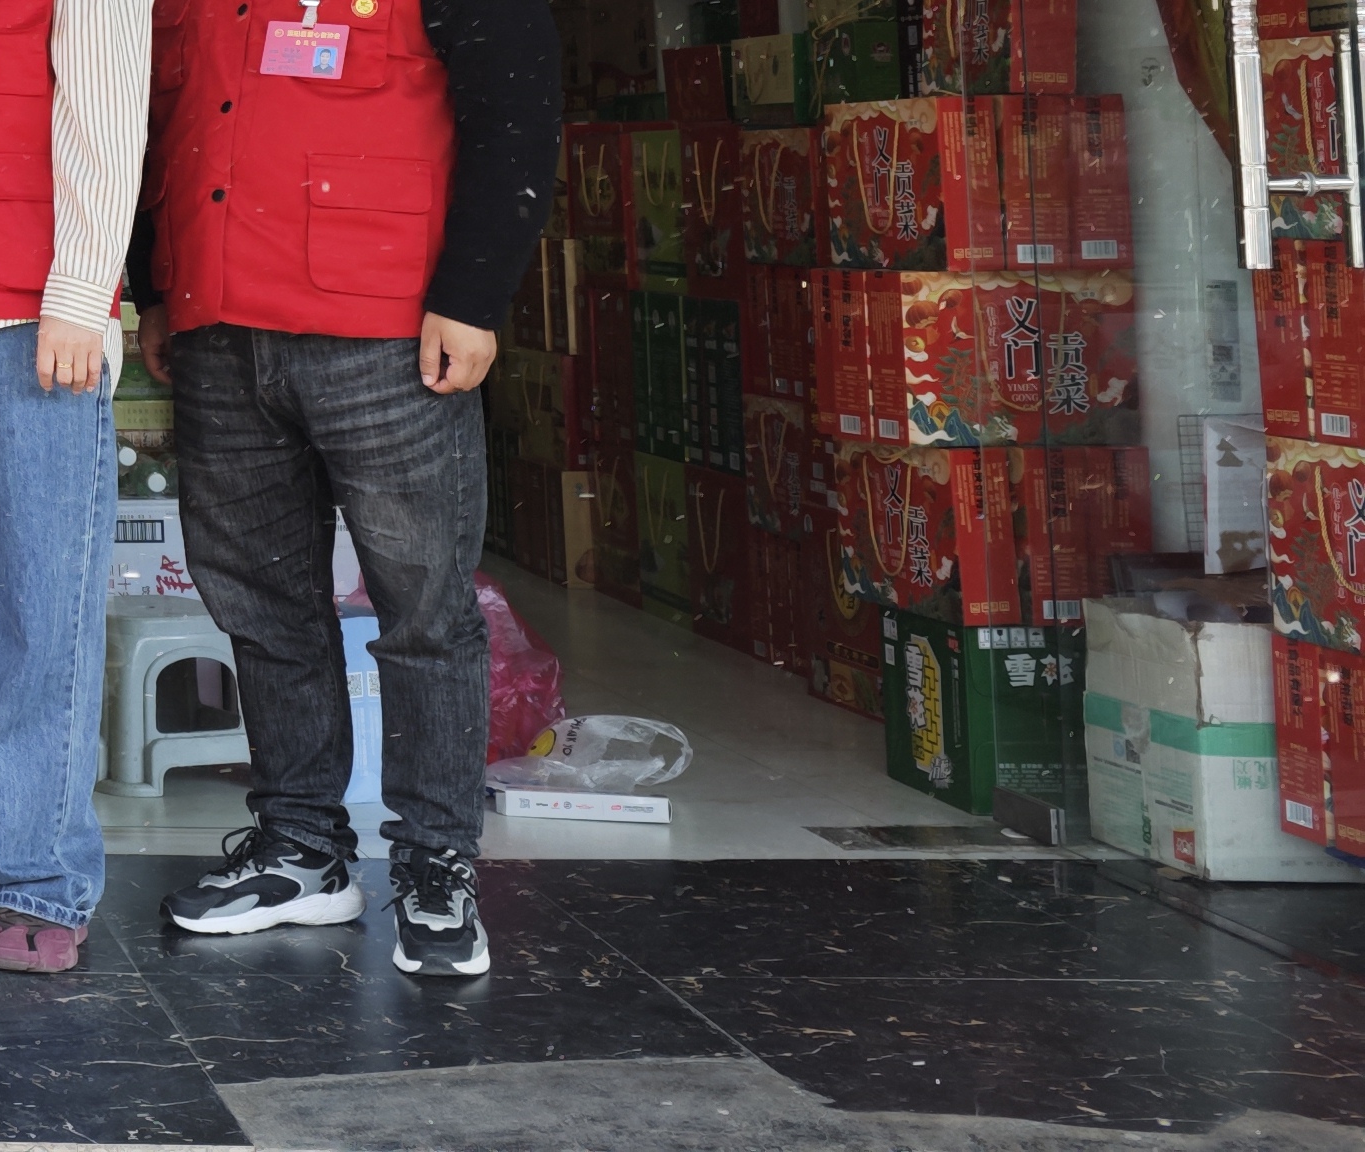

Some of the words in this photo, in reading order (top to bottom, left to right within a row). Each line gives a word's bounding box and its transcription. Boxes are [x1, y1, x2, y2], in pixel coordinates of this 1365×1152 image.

[1001, 295, 1042, 380] 义门
[1045, 331, 1091, 416] 贡菜
[1007, 382, 1039, 393] YIMEN
